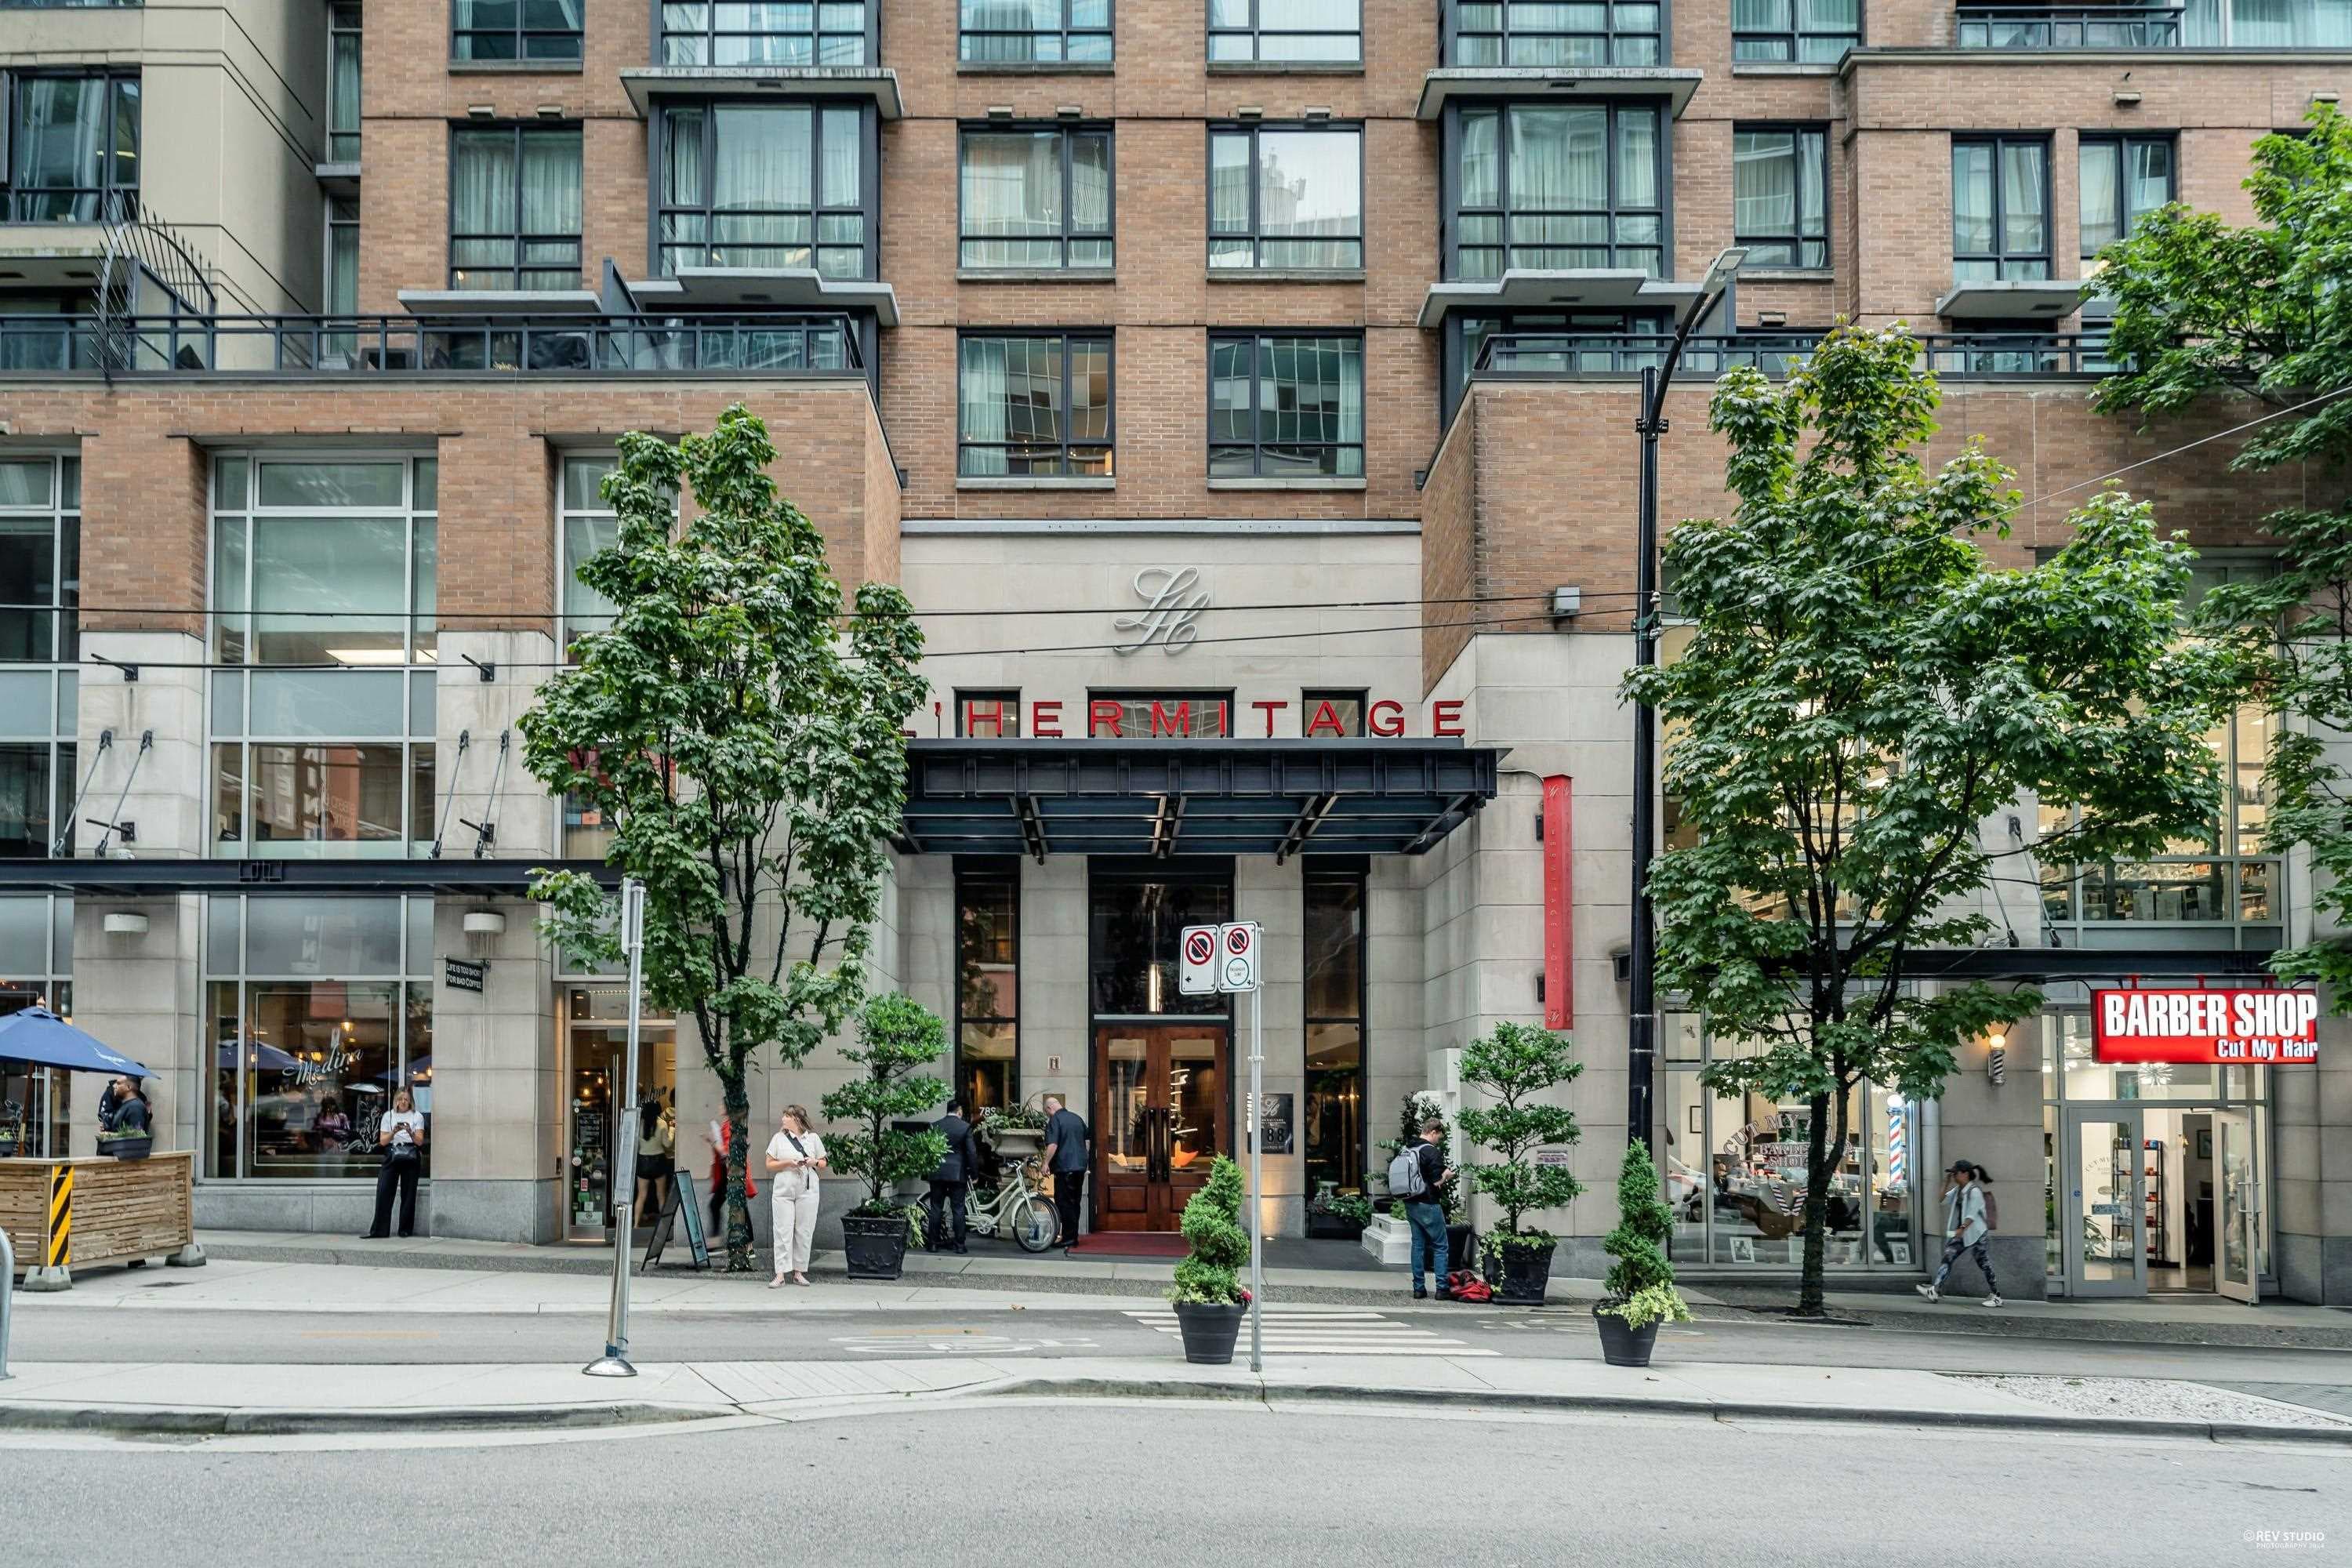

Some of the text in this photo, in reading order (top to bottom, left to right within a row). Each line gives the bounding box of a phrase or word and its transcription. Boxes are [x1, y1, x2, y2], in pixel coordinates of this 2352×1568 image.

[898, 700, 1465, 739] 'HERMITAGE
[447, 974, 456, 984] FOR
[2104, 993, 2318, 1037] BARBER SHOP
[282, 1047, 363, 1086] Medina
[2218, 1038, 2318, 1060] Cut My Hair
[1723, 1113, 1800, 1155] CUT MY
[1759, 1144, 1809, 1156] BARBE
